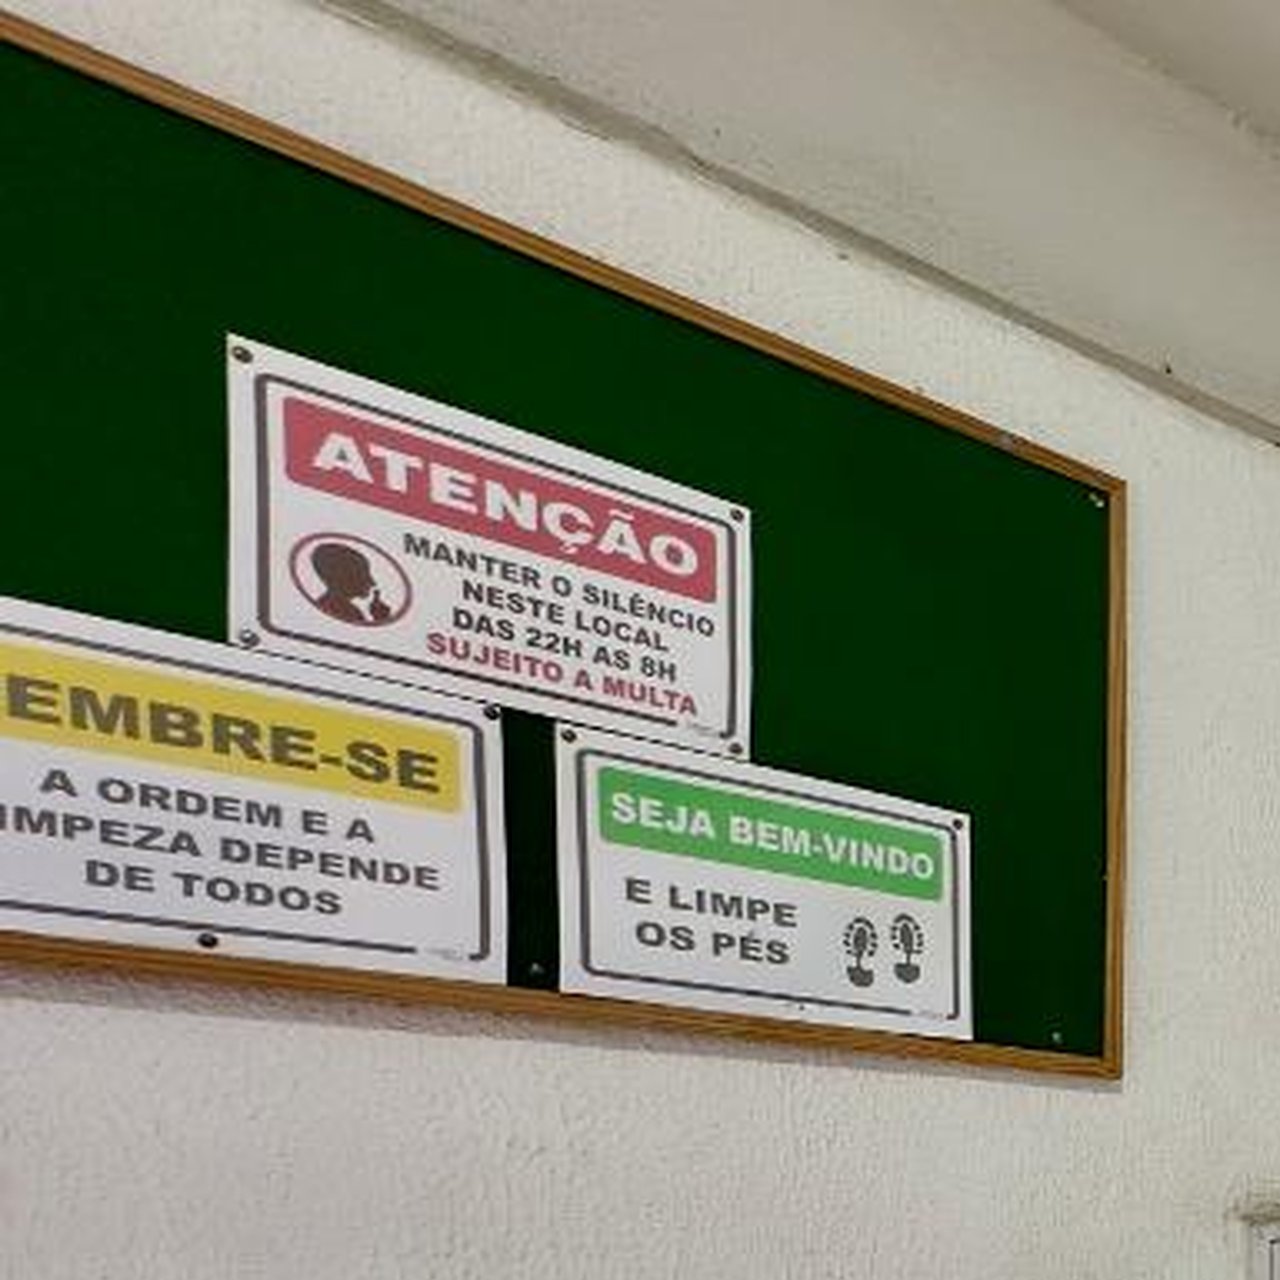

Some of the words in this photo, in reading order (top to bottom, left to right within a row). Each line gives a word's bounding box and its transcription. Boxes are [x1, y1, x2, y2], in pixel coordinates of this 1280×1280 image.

[312, 431, 699, 579] ATENÇÃO
[403, 532, 542, 592] MANTER
[551, 573, 573, 597] O
[452, 607, 516, 642] DAS
[526, 627, 584, 659] 22H
[592, 645, 631, 673] AS
[640, 655, 678, 684] 8H
[462, 577, 565, 626] NESTE
[575, 608, 669, 653] LOCAL
[426, 631, 565, 684] SUJEITO
[573, 668, 595, 691] A
[602, 674, 698, 717] MULTA
[6, 673, 442, 794] EMBRE-SE
[39, 768, 78, 799] A
[97, 777, 283, 830] ORDEM
[302, 809, 330, 837] E
[345, 817, 376, 845] A
[611, 792, 717, 841] SEJA
[728, 815, 936, 880] BEM-VINDO
[85, 859, 156, 894] DE
[172, 872, 343, 917] TODOS
[219, 837, 441, 893] DEPENDE
[625, 876, 651, 906] E
[668, 884, 798, 929] LIMPE
[635, 921, 696, 953] OS
[711, 927, 790, 965] PÉS
